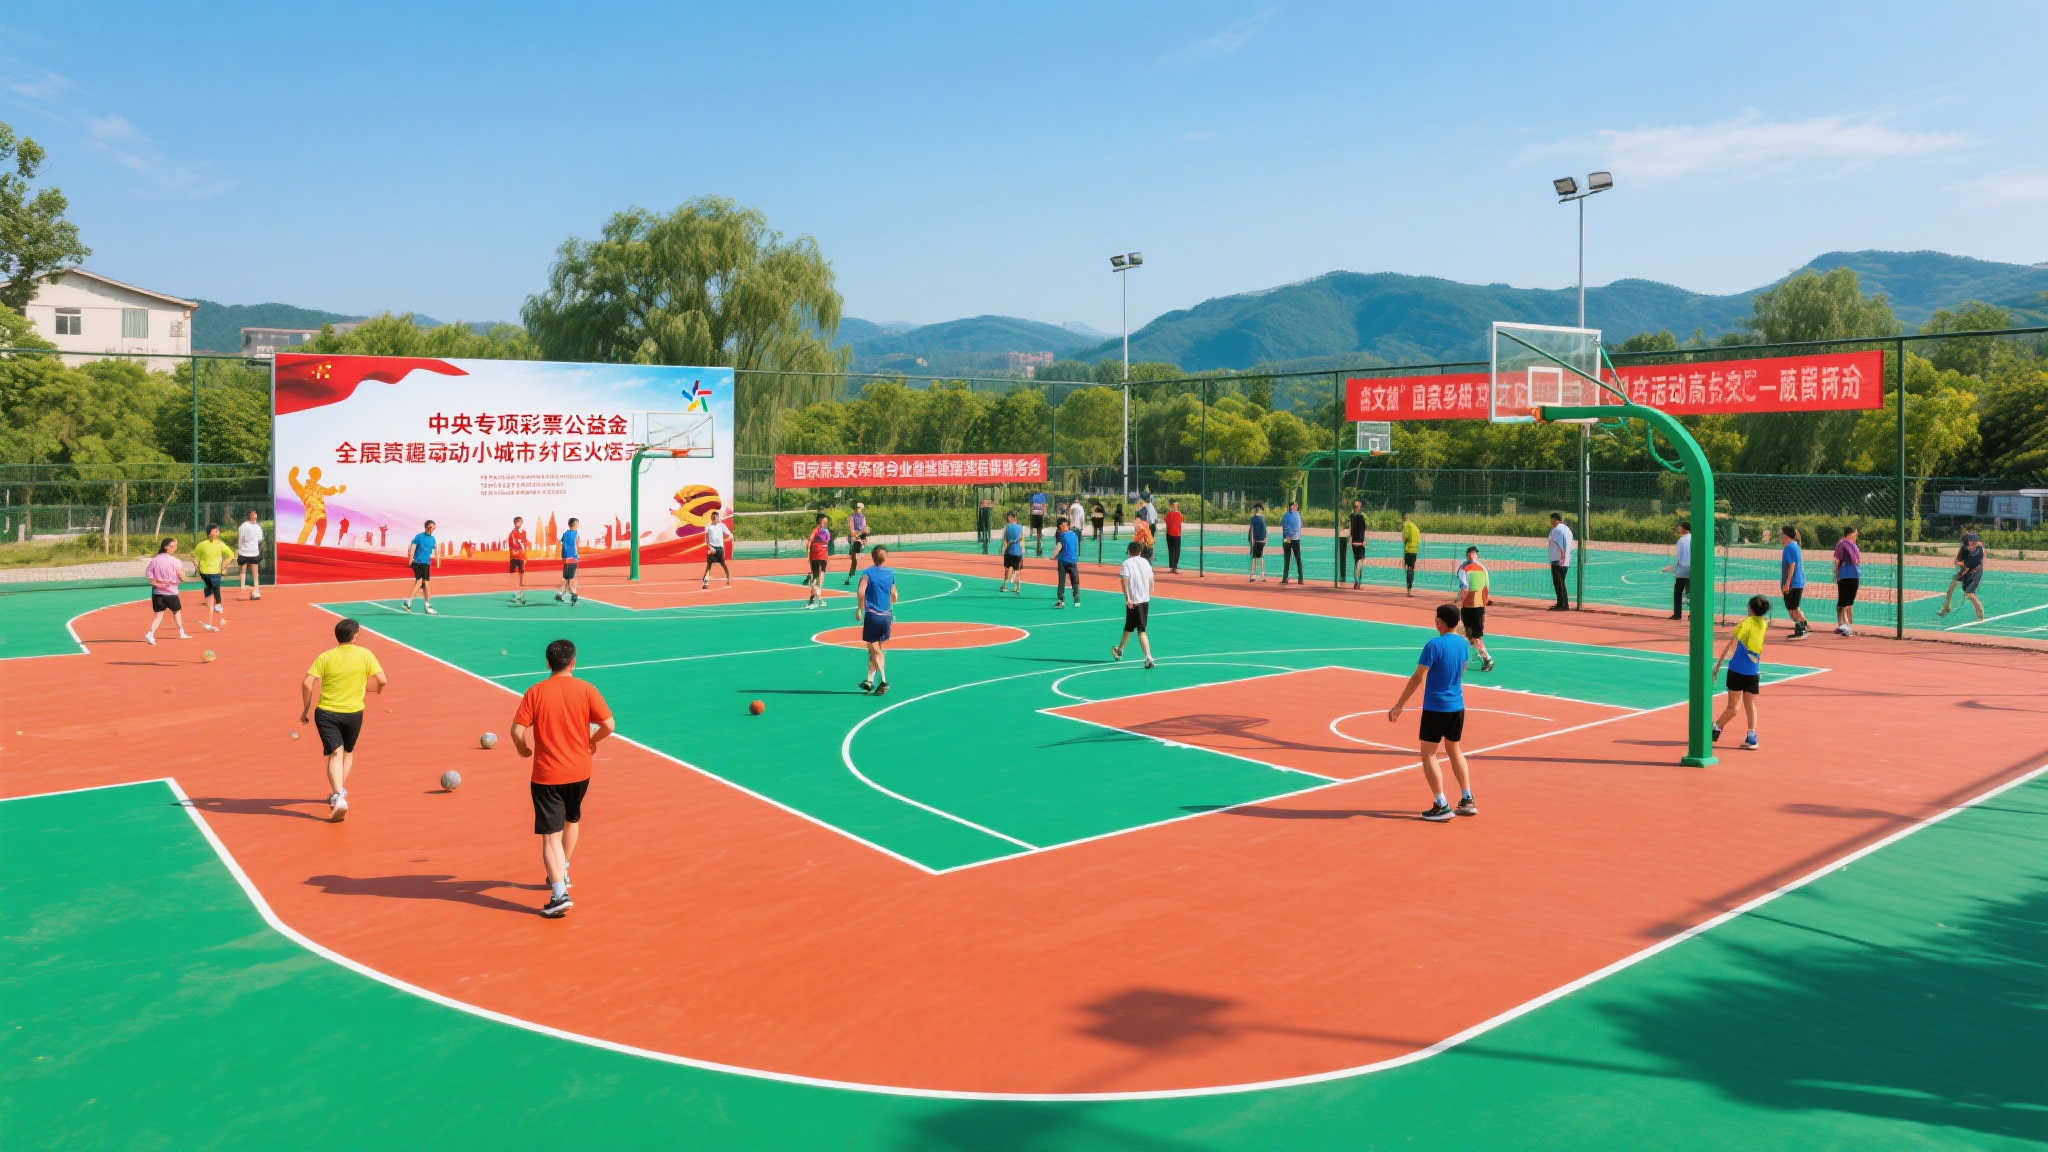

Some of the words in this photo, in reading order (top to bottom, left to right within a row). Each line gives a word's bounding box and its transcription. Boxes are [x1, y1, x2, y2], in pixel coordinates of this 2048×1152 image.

[428, 412, 628, 436] 中央专项彩票公益金
